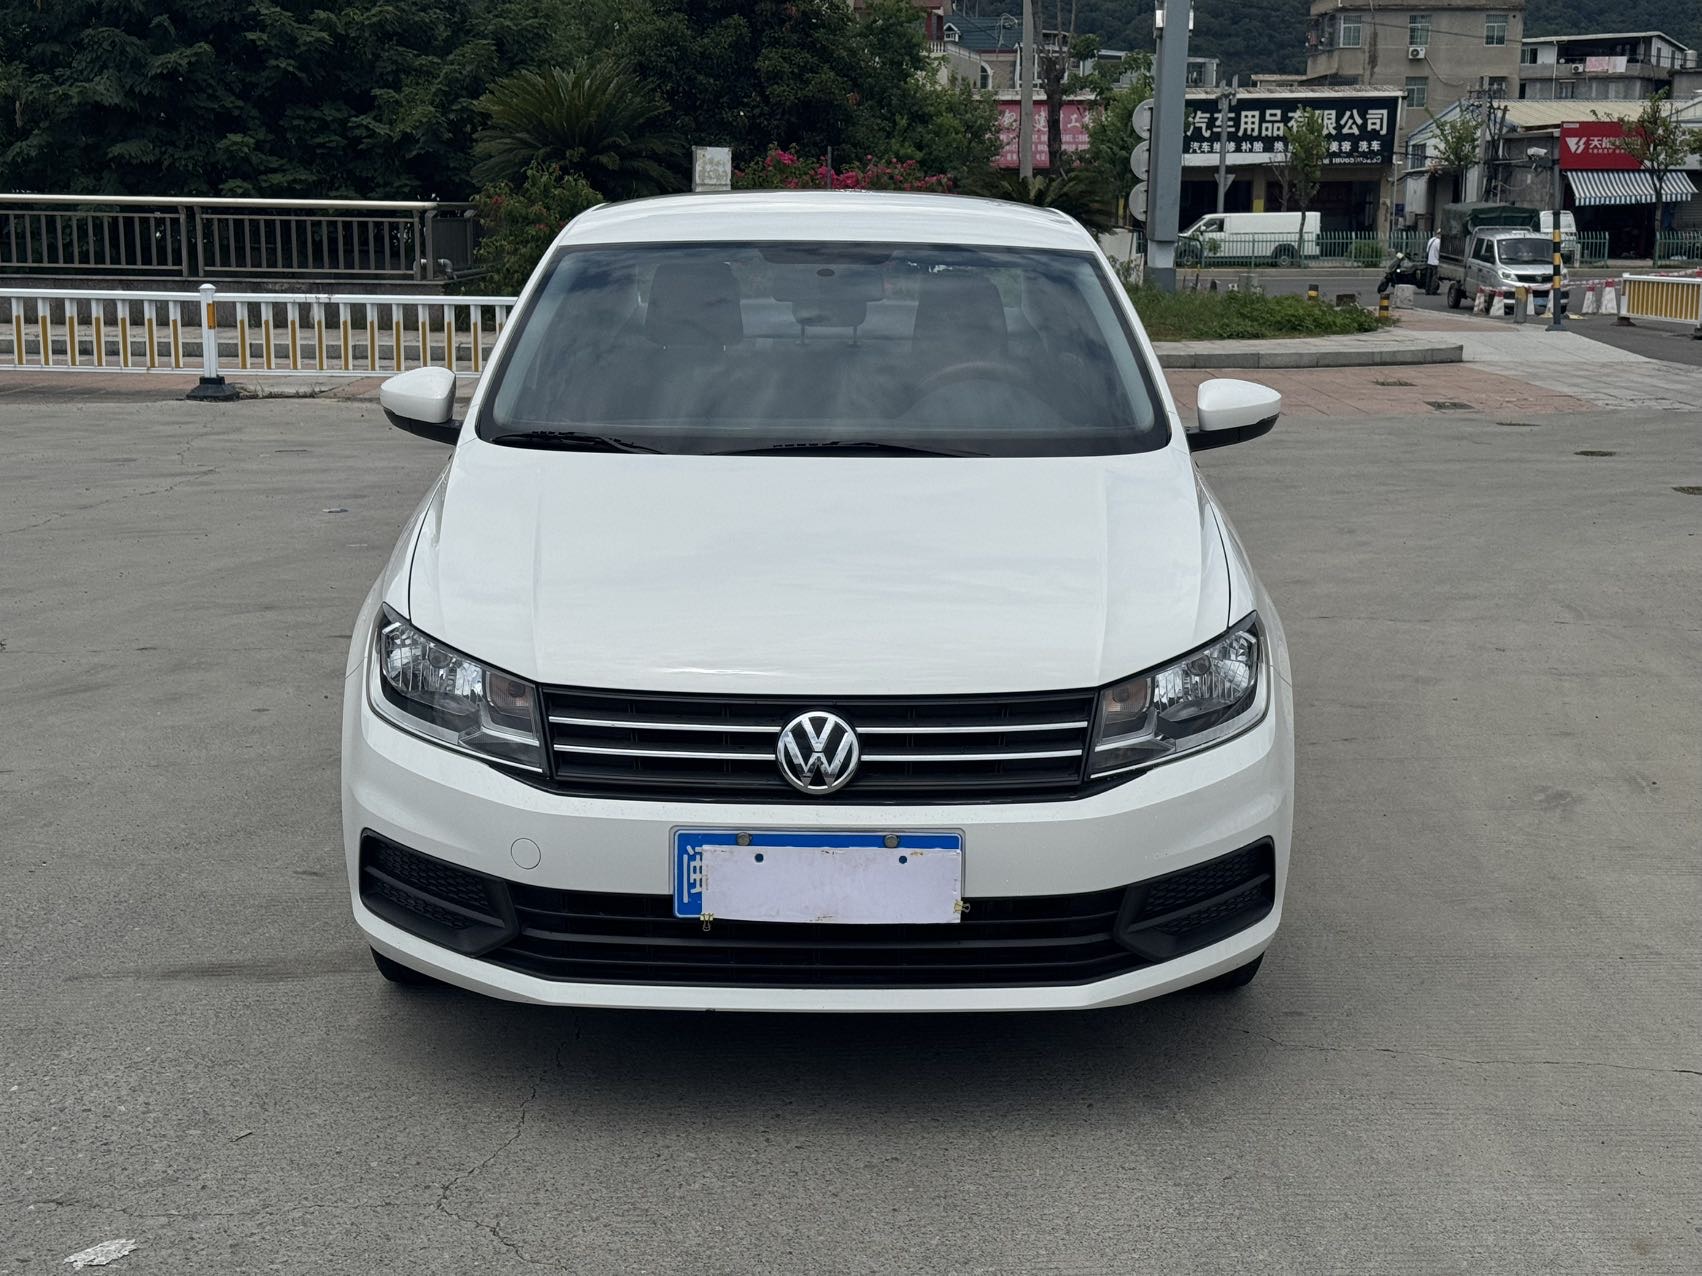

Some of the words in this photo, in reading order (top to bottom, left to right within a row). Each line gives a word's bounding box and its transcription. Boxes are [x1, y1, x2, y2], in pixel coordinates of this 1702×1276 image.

[1241, 141, 1264, 153] 补胎
[1358, 140, 1381, 152] 洗车
[779, 713, 858, 793] VW
